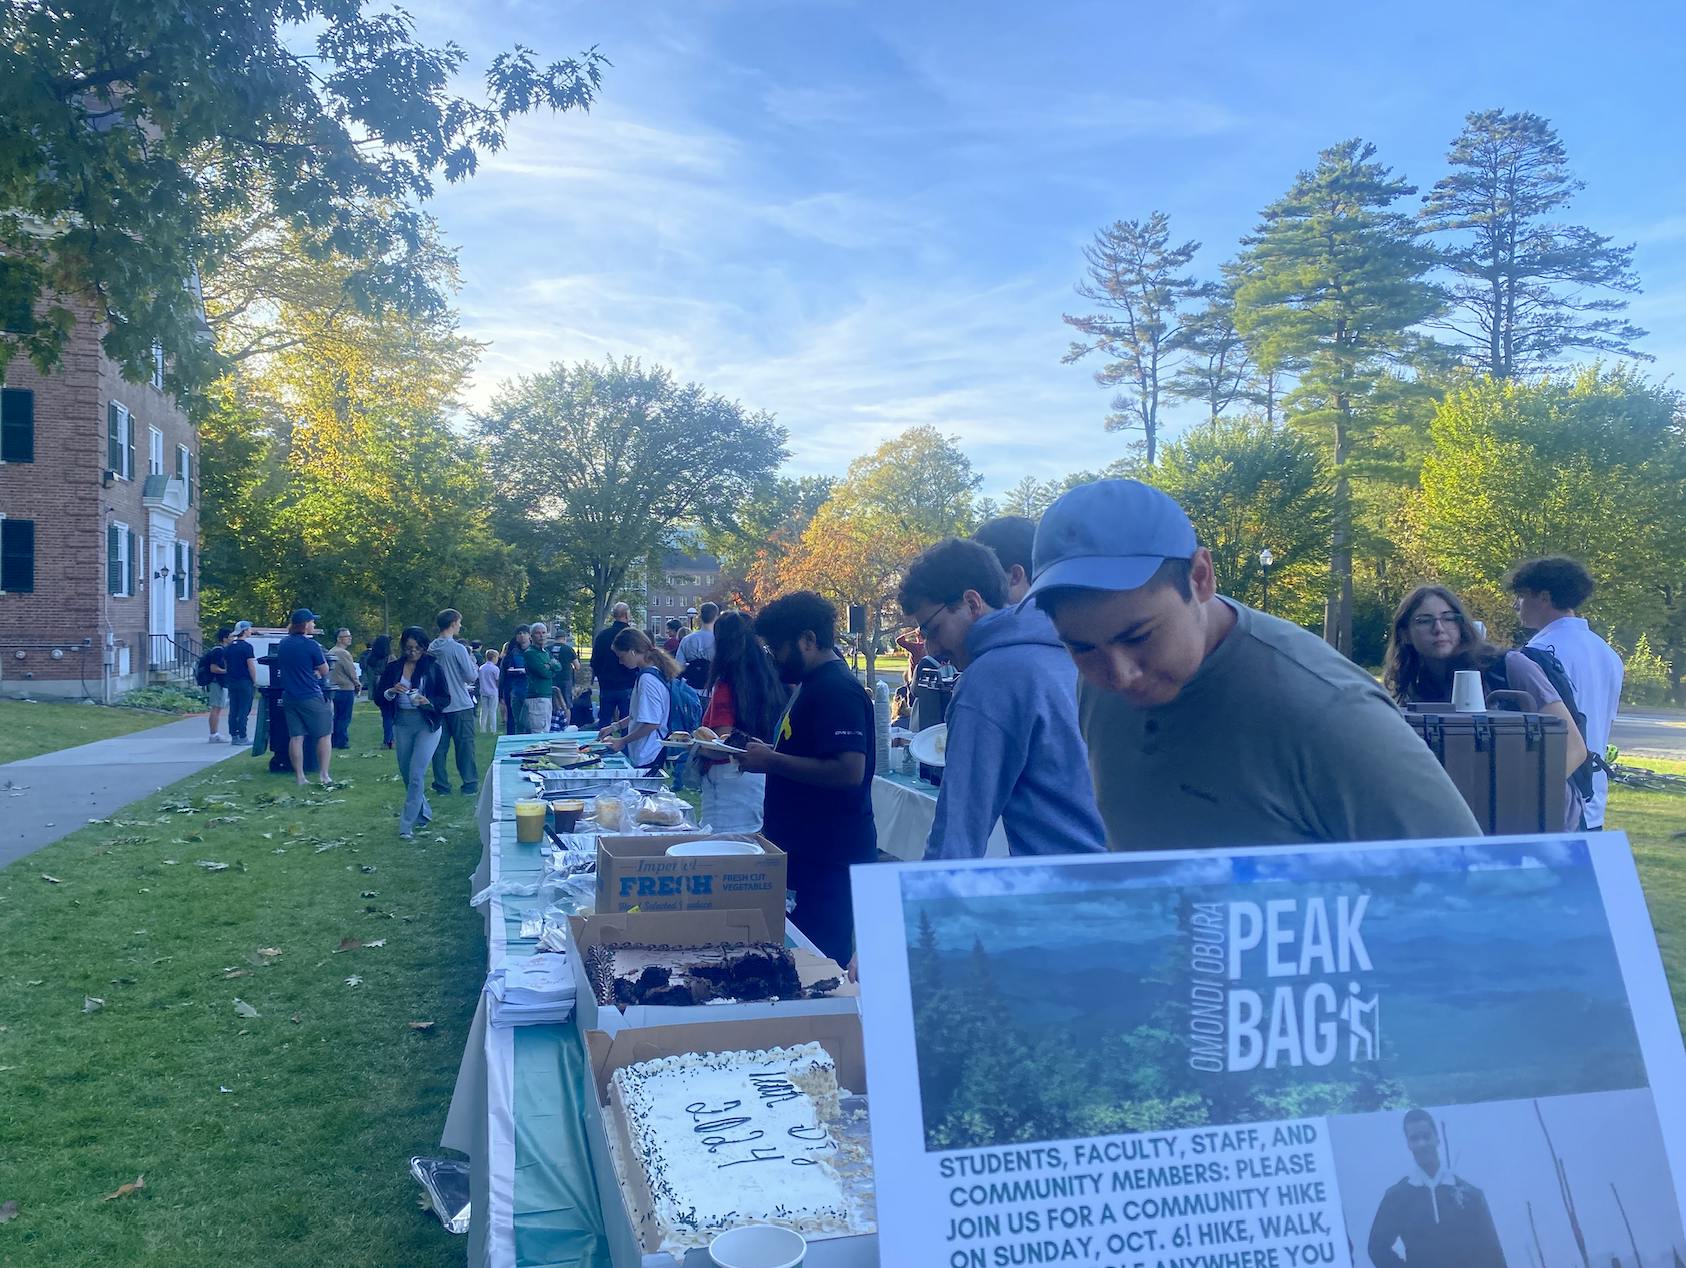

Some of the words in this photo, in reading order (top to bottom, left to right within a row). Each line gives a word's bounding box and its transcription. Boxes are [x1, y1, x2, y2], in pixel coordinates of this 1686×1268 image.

[723, 881, 772, 891] VEGETABLES
[1190, 903, 1224, 974] OBURA
[1228, 895, 1374, 980] PEAK
[1190, 980, 1224, 1073] OMONDI
[1228, 982, 1338, 1072] BAG
[686, 1100, 785, 1168] 2024
[940, 1148, 1067, 1178] STUDENTS,
[1074, 1136, 1185, 1165] FACULTY,
[1192, 1130, 1264, 1154] STAFF,
[1273, 1125, 1316, 1146] AND
[950, 1173, 1102, 1207] COMMUNITY
[1112, 1162, 1229, 1192] MEMBERS:
[1236, 1153, 1315, 1179] PLEASE
[947, 1214, 1000, 1241] JOIN
[1008, 1211, 1040, 1234] US
[1047, 1206, 1093, 1230] FOR
[1100, 1203, 1116, 1224] A
[1123, 1188, 1269, 1221] COMMUNITY
[1277, 1182, 1325, 1205] HIKE
[950, 1248, 986, 1268] ON
[994, 1237, 1100, 1267] SUNDAY,
[1107, 1230, 1164, 1254] OCT.
[1172, 1224, 1192, 1248] 6!
[1198, 1220, 1253, 1245] HIKE,
[1259, 1212, 1330, 1238] WALK,
[1284, 1242, 1334, 1266] YOU
